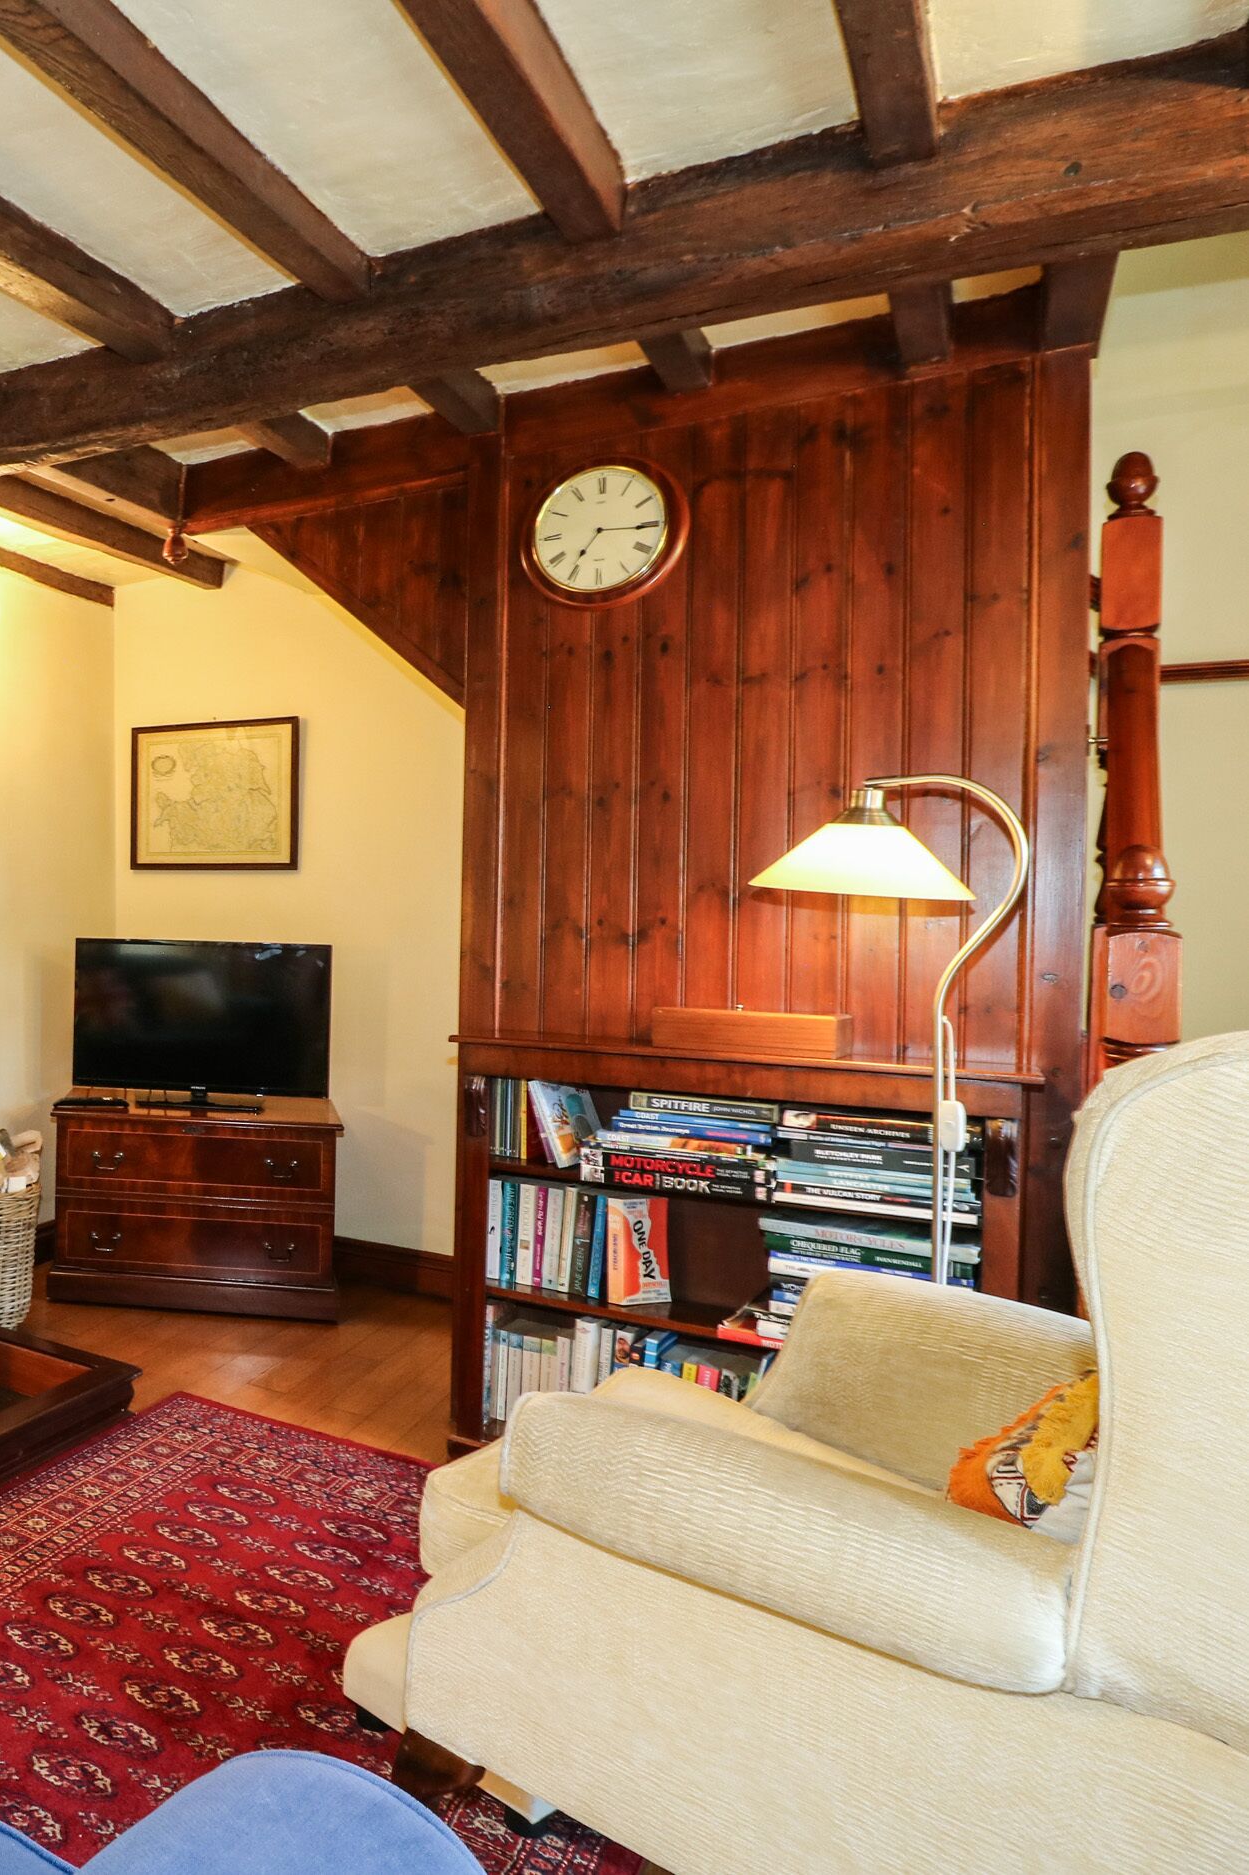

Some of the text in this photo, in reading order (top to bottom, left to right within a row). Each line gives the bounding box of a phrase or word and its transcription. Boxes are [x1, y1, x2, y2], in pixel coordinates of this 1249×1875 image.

[651, 1098, 710, 1113] SPITFIRE
[730, 1107, 757, 1116] NICHOL
[635, 1111, 660, 1120] COAST
[606, 1133, 630, 1142] COAST
[830, 1124, 911, 1139] UNSEEN ARCHIVES
[858, 1152, 883, 1161] PARK
[609, 1154, 717, 1178] MOTORCYCLE
[621, 1171, 712, 1194] CAR BOOK
[506, 1187, 515, 1204] JANE
[821, 1188, 855, 1199] VULCAN
[857, 1191, 882, 1202] STORY
[506, 1206, 514, 1229] GREEN
[633, 1220, 656, 1280] ONE DAY
[790, 1239, 861, 1255] CHEQUERED FLAG
[575, 1273, 585, 1292] JANE
[754, 1312, 769, 1321] The
